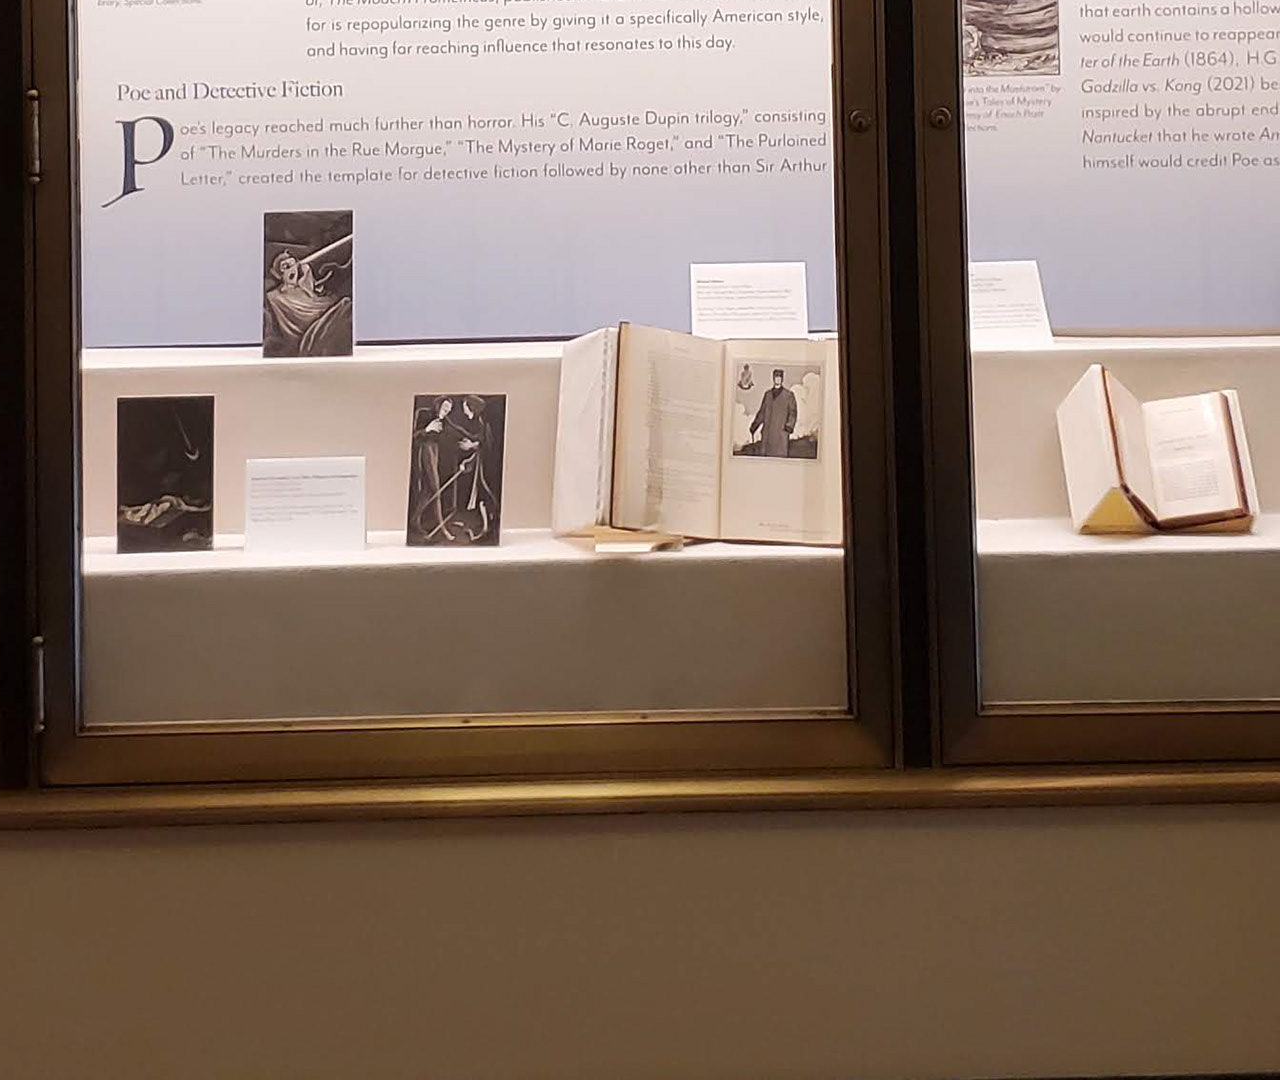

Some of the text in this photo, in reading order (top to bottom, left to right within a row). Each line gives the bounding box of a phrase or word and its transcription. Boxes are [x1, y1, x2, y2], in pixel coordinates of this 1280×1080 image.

[1079, 57, 1100, 68] ter
[1100, 53, 1118, 68] of
[1117, 54, 1141, 68] the
[1141, 52, 1181, 67] Earth
[116, 81, 344, 101] Poe and Detective Fiction
[1080, 78, 1140, 93] Godzilla
[1163, 78, 1203, 95] Kong
[1206, 76, 1256, 94] (2021)
[211, 121, 263, 138] legacy
[263, 118, 325, 134] reached
[329, 117, 371, 132] much
[374, 116, 426, 131] further
[428, 116, 463, 130] than
[518, 113, 546, 128] His
[578, 113, 641, 130] Auguste
[644, 111, 690, 129] Dupin
[753, 109, 827, 127] consisting
